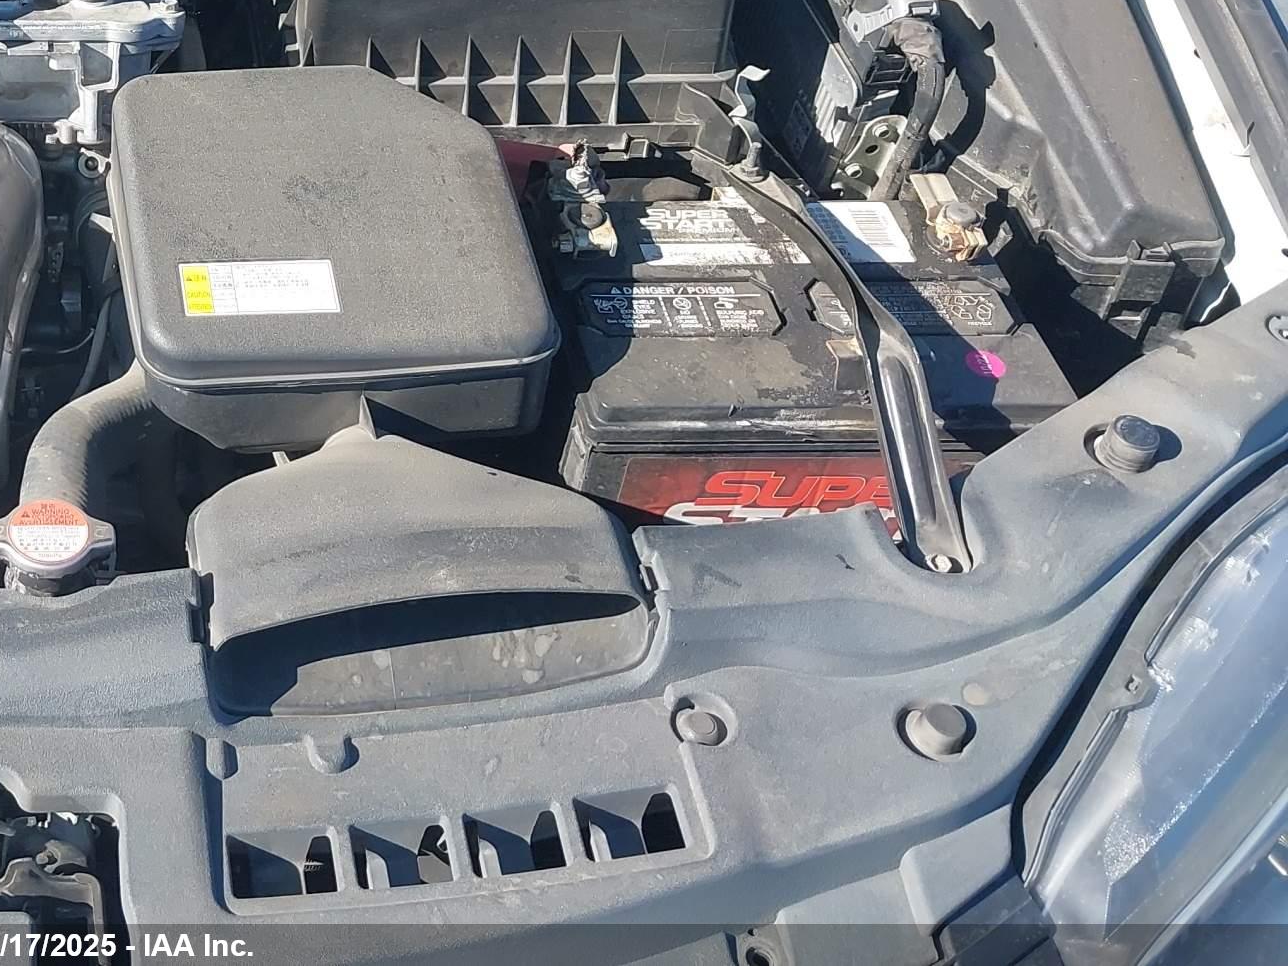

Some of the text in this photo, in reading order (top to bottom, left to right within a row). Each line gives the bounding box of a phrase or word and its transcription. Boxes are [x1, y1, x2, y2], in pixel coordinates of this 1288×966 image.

[645, 208, 729, 220] SUPER
[639, 218, 734, 230] START
[623, 287, 675, 295] DANGER
[686, 286, 735, 295] POISON
[695, 471, 893, 508] SUPE
